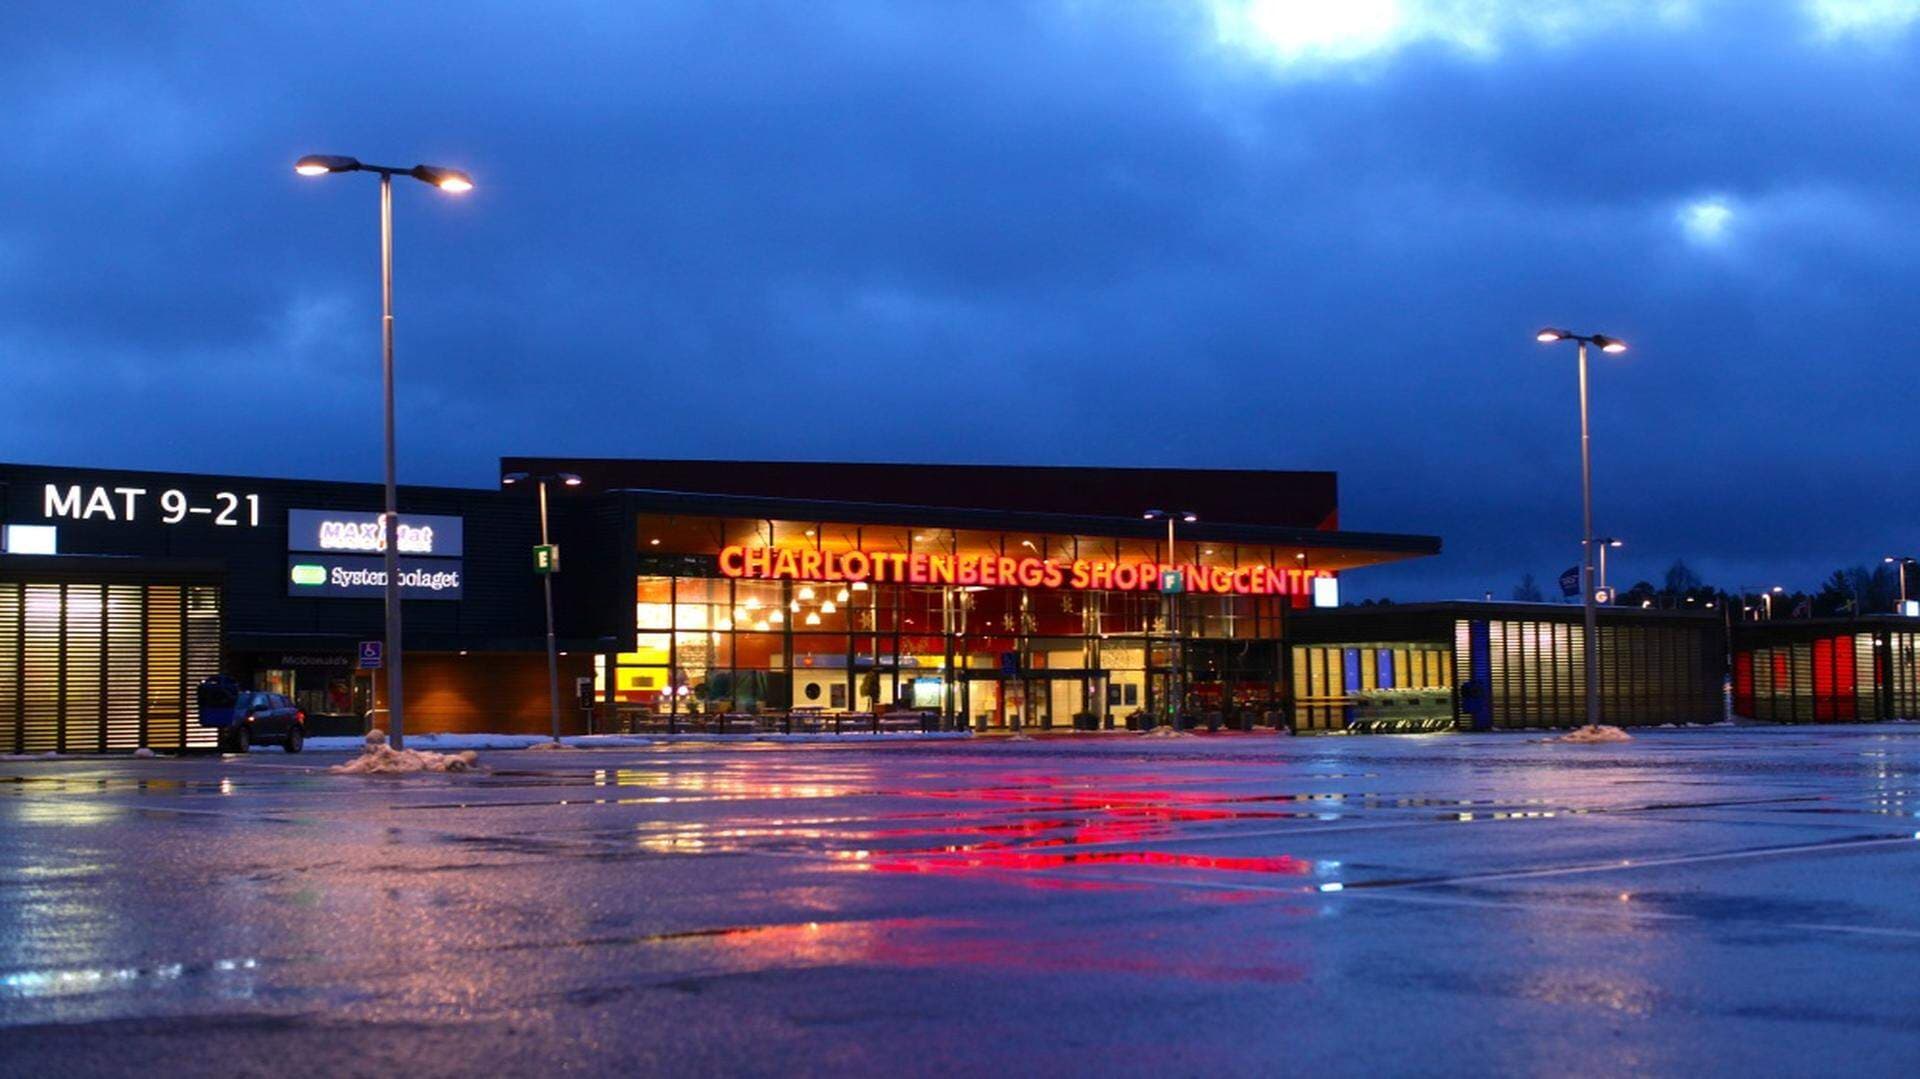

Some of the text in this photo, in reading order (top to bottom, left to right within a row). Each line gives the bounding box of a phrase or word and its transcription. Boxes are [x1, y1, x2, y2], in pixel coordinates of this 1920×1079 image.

[44, 484, 146, 521] MAT
[539, 551, 548, 568] E
[718, 546, 1063, 588] CHARLOTTENBERGS
[1165, 574, 1175, 589] F
[1595, 591, 1608, 603] G
